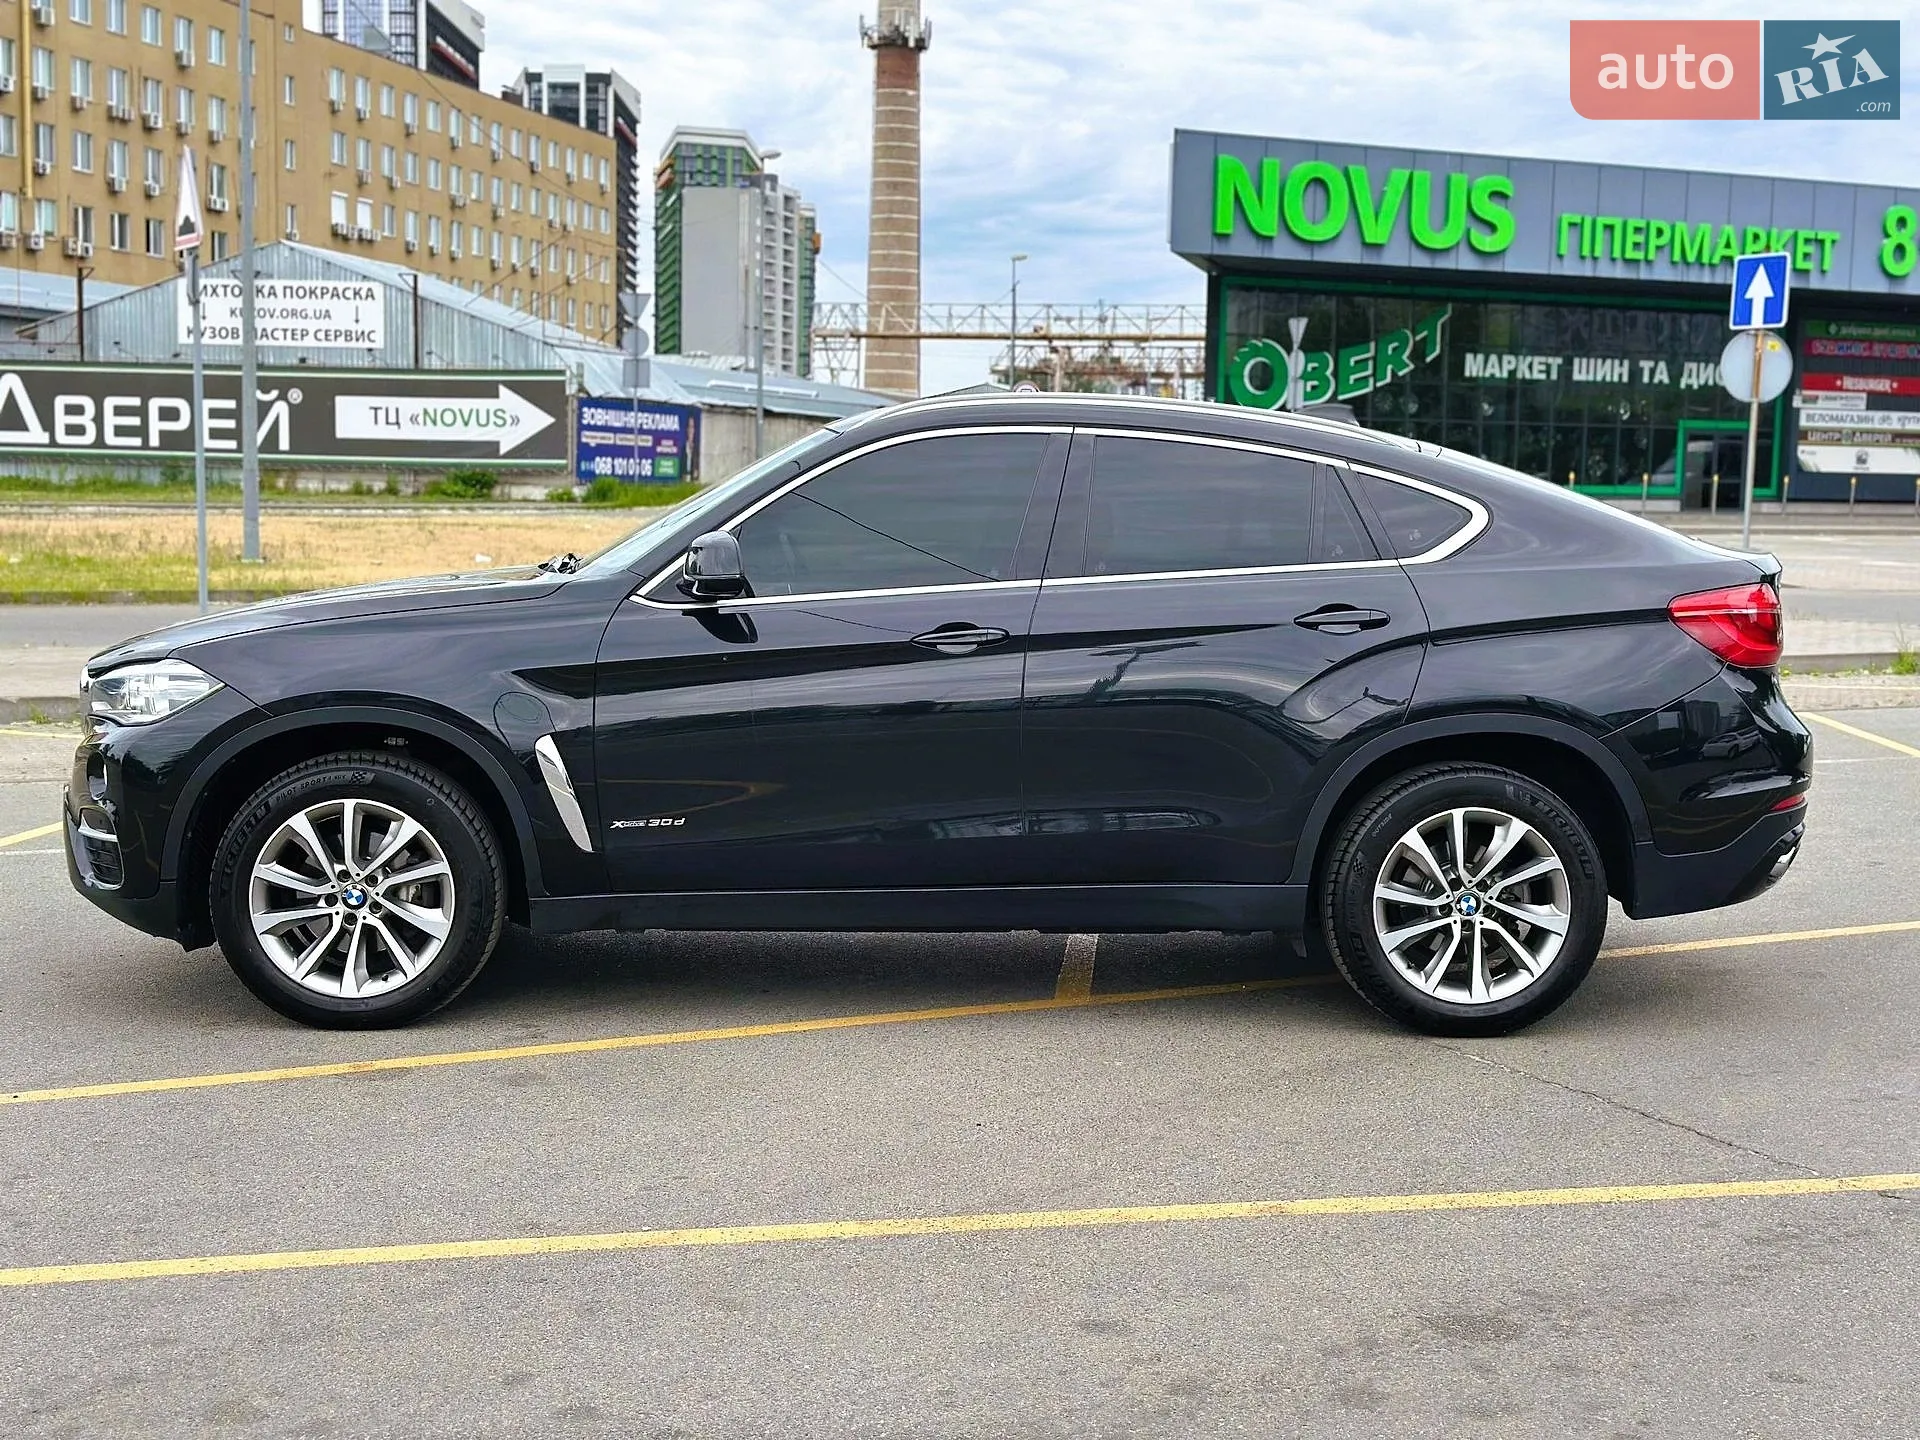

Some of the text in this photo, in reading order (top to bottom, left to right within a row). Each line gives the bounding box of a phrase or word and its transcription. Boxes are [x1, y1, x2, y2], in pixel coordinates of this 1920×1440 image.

[1213, 153, 1516, 253] NOVUS
[1558, 213, 1841, 272] ГІПЕРМАРКЕТ
[190, 284, 376, 300] ИХТОКА ПОКРАСКА
[229, 307, 332, 320] KOV.ORG.UA
[246, 327, 309, 342] АСТЕР
[314, 328, 376, 343] СЕРВИС
[1229, 303, 1453, 411] OBERT
[1464, 353, 1563, 381] МАРКЕТ
[1572, 357, 1629, 383] ШИН
[1639, 360, 1670, 385] ТА
[369, 406, 521, 429] ТЦ «NOVUS»
[637, 412, 679, 431] РЕКЛАМА
[1805, 412, 1874, 425] ВЕЛОМАГАЗИН
